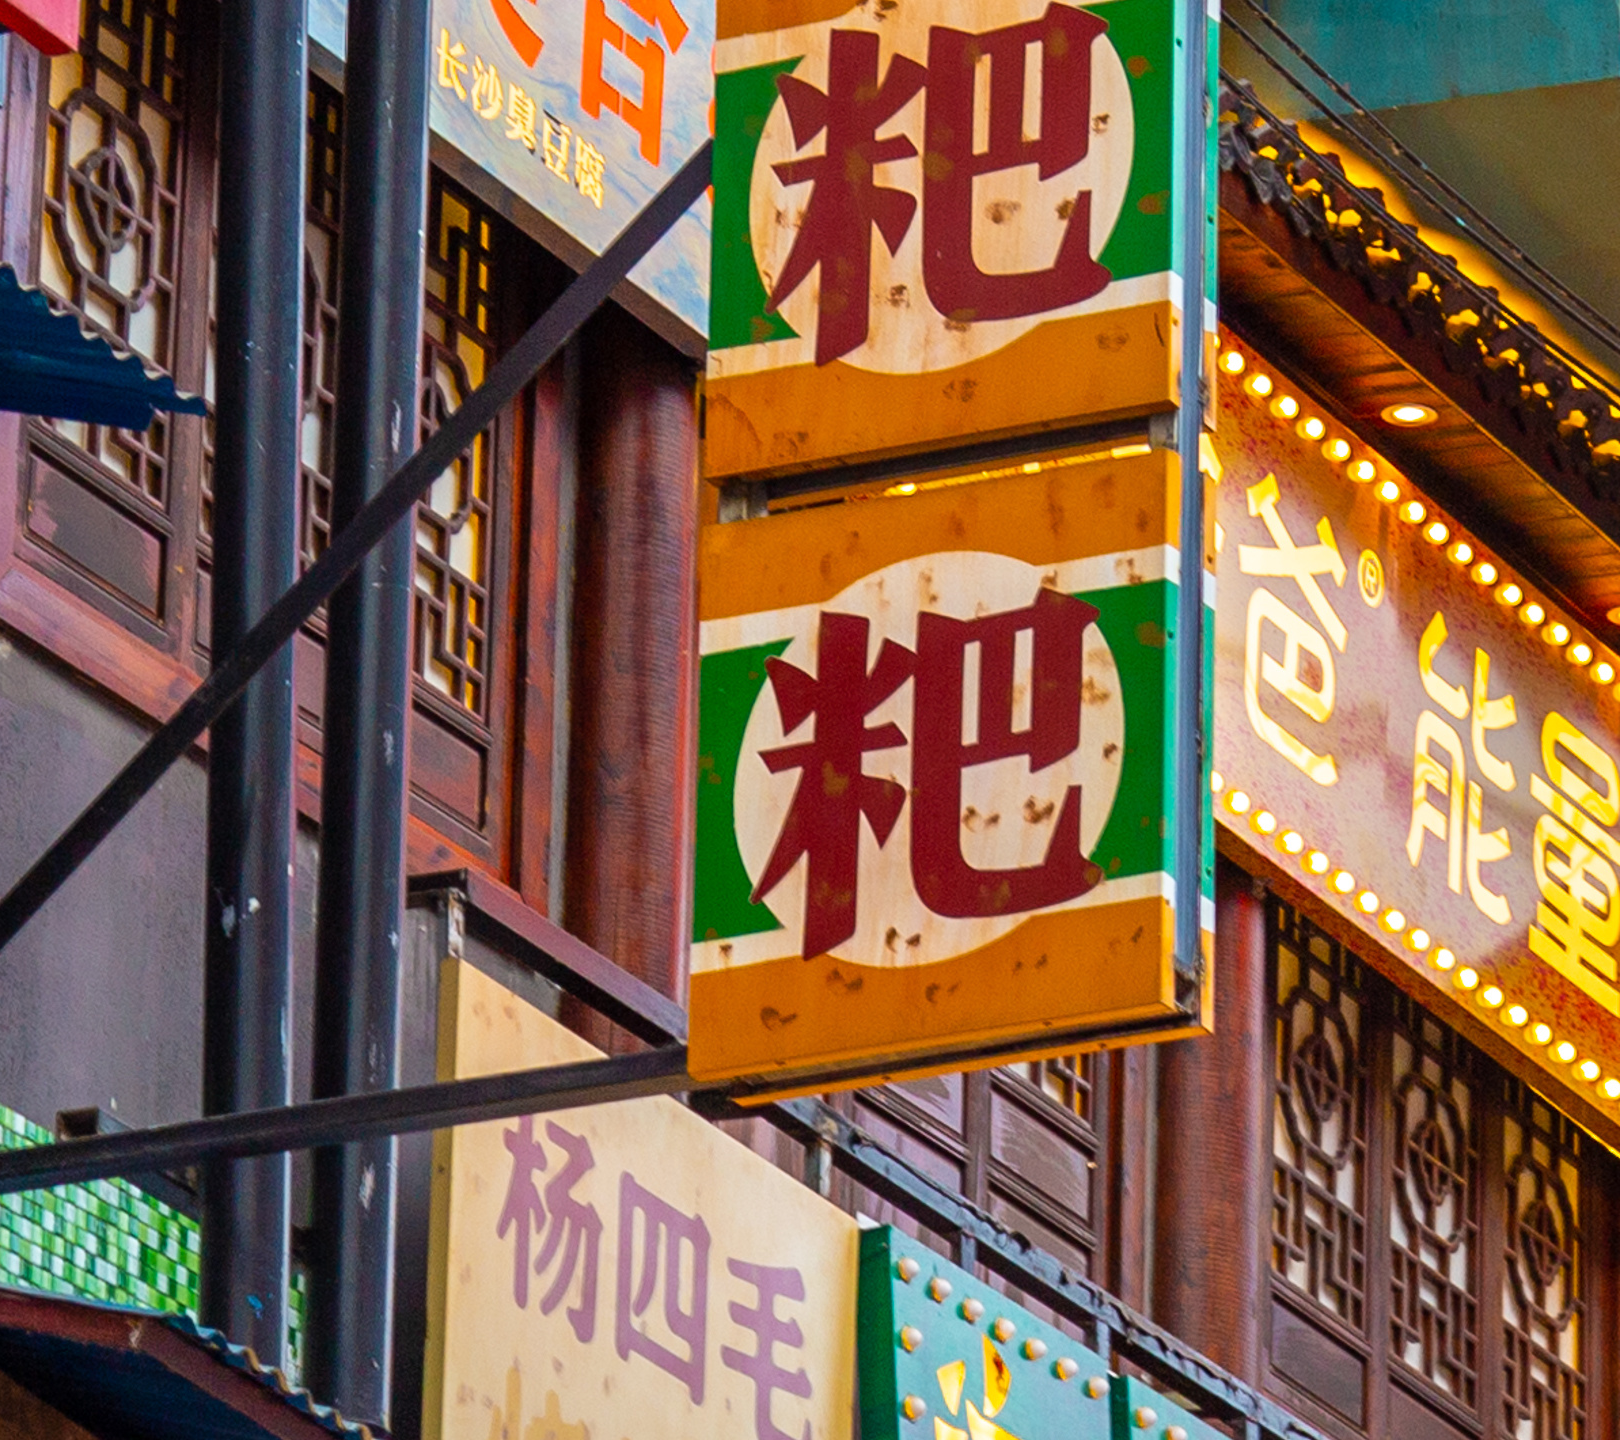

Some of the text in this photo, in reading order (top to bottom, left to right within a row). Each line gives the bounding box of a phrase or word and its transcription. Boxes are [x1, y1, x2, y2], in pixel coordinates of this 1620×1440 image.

[435, 26, 608, 211] 长沙臭豆腐
